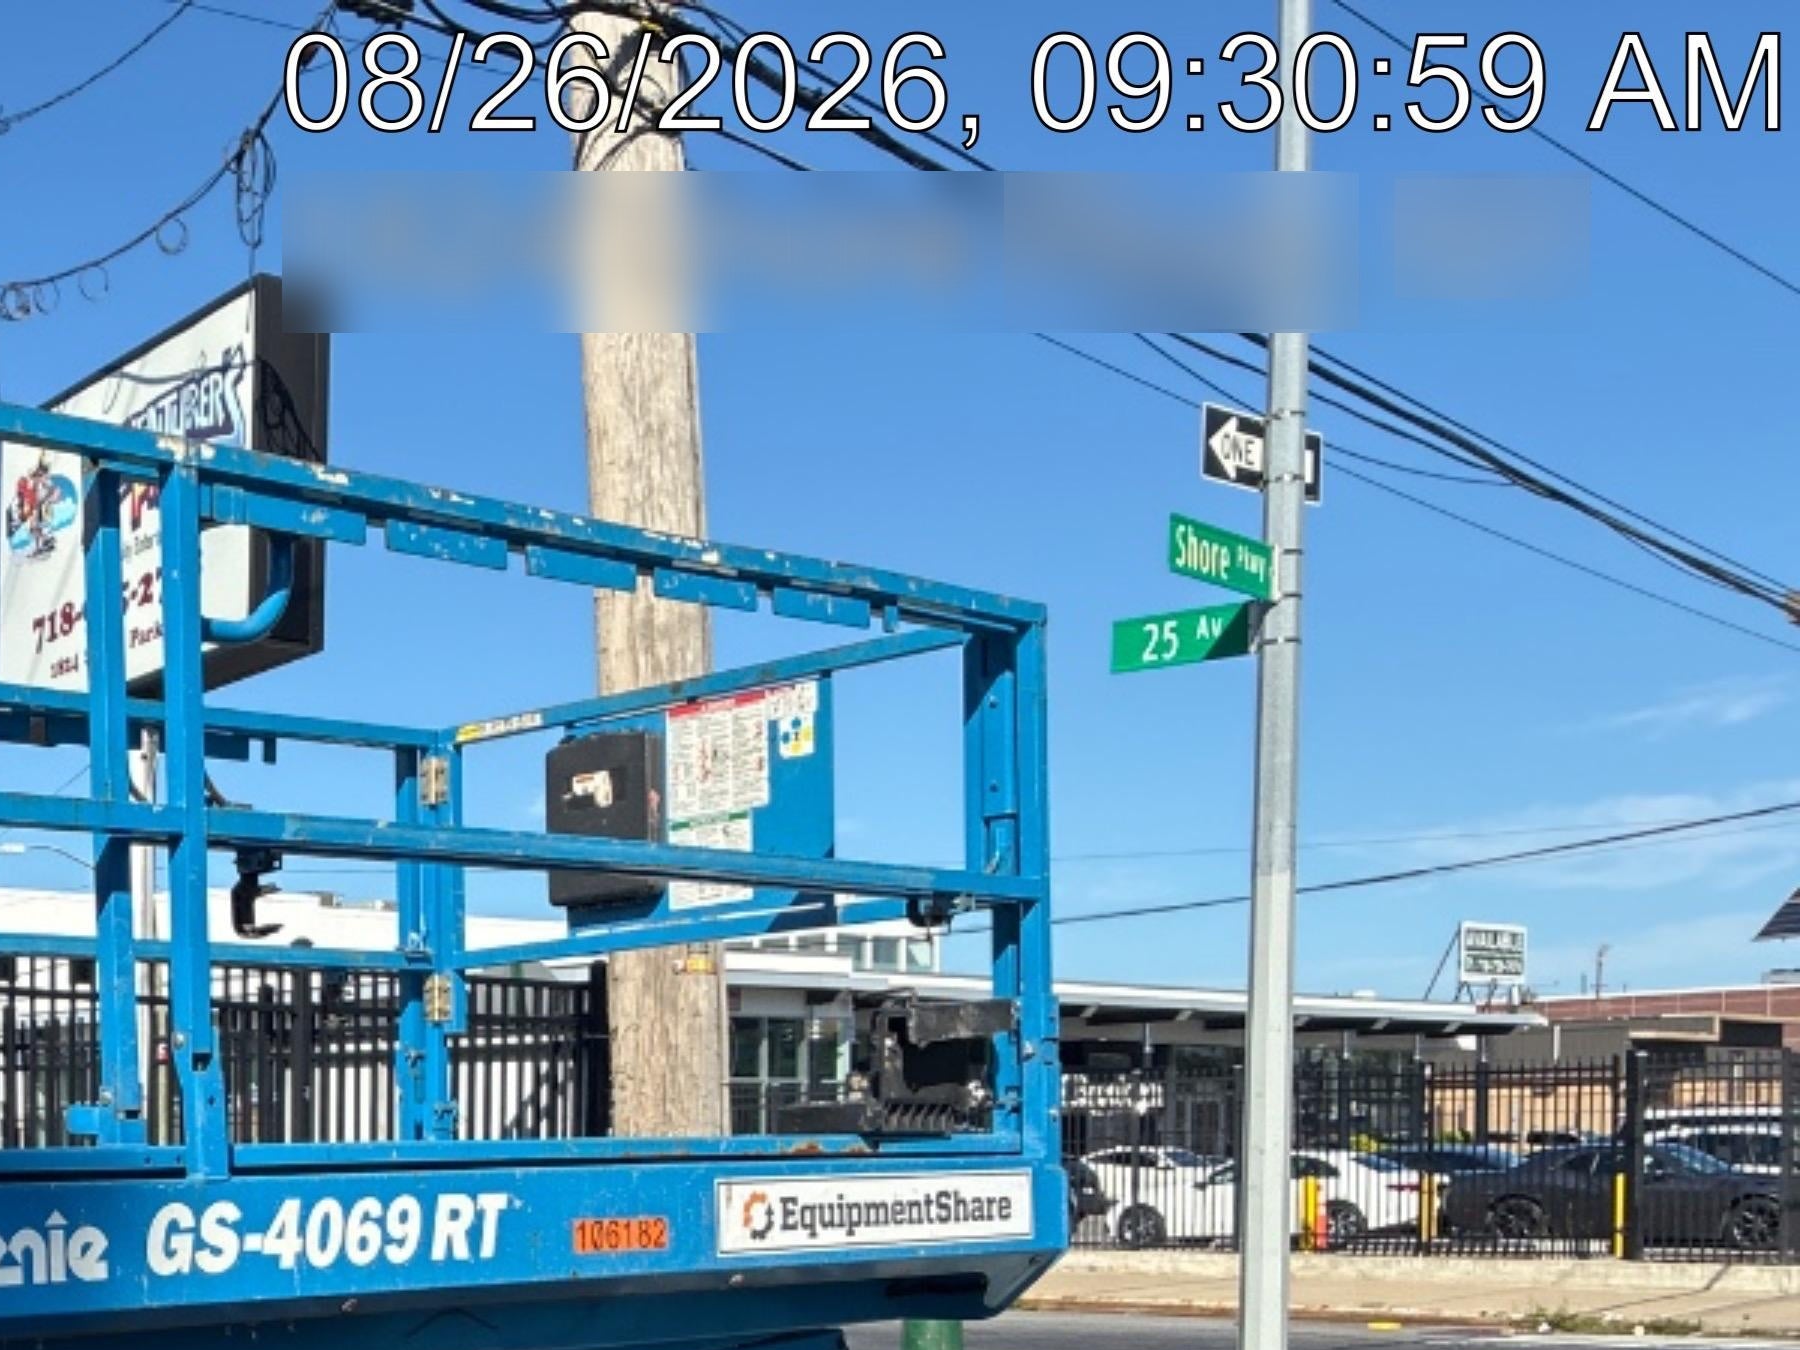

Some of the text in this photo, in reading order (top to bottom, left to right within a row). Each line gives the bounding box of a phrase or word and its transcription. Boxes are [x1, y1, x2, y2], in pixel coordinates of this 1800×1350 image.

[1221, 431, 1256, 466] ONE
[1175, 523, 1231, 581] Shore
[1141, 614, 1223, 662] 25 Av
[145, 1192, 509, 1277] GS-4069 RT
[576, 1218, 667, 1252] 106182
[779, 1190, 1013, 1239] EquipmentShare
